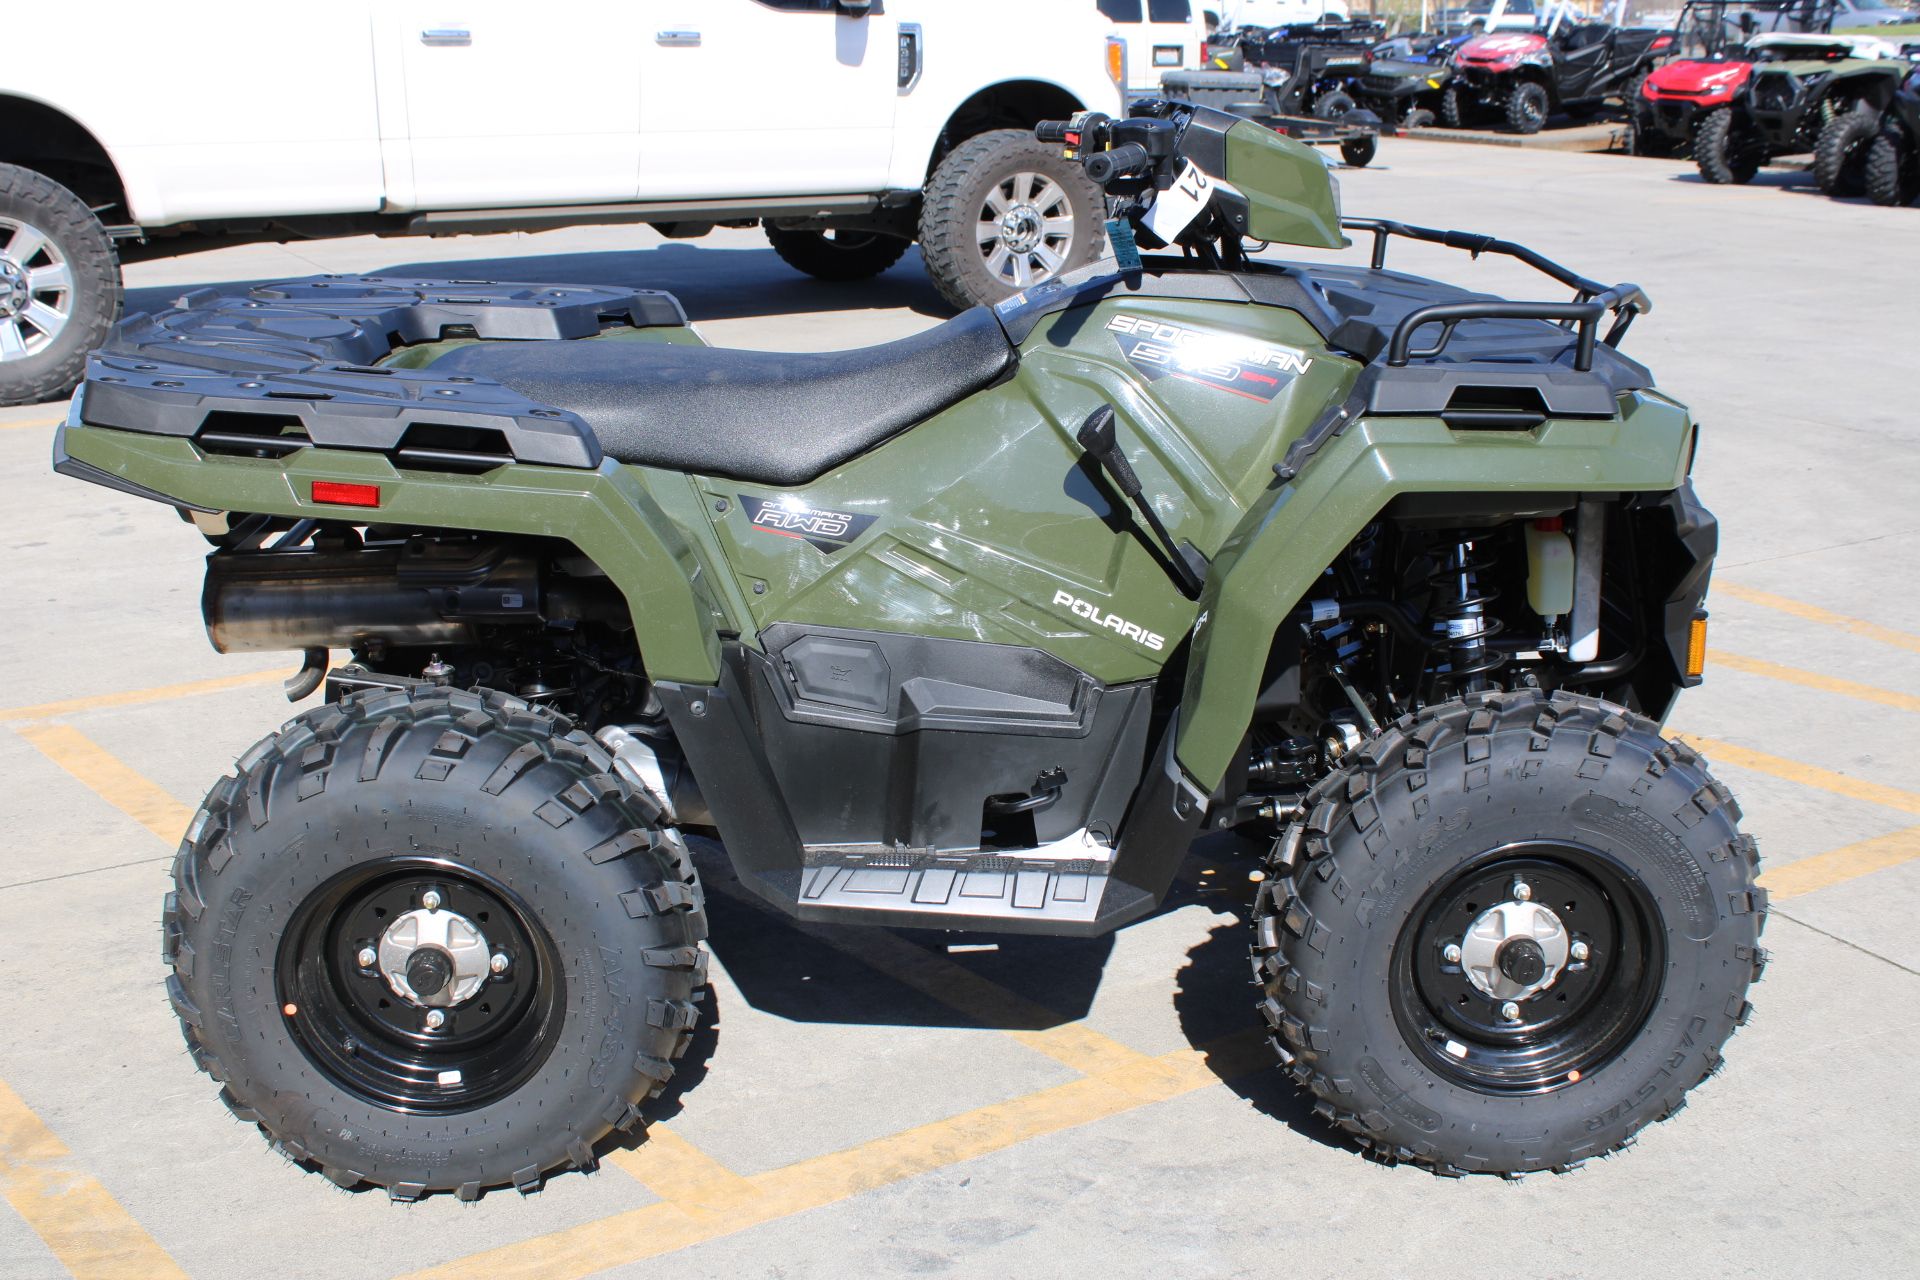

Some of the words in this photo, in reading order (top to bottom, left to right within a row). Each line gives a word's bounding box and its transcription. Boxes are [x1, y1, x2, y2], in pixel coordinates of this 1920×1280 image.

[1179, 167, 1207, 202] 21
[1106, 314, 1315, 375] SPORMAN
[1129, 341, 1241, 382] 50
[754, 509, 848, 536] AWD
[1052, 589, 1166, 651] POLARIS
